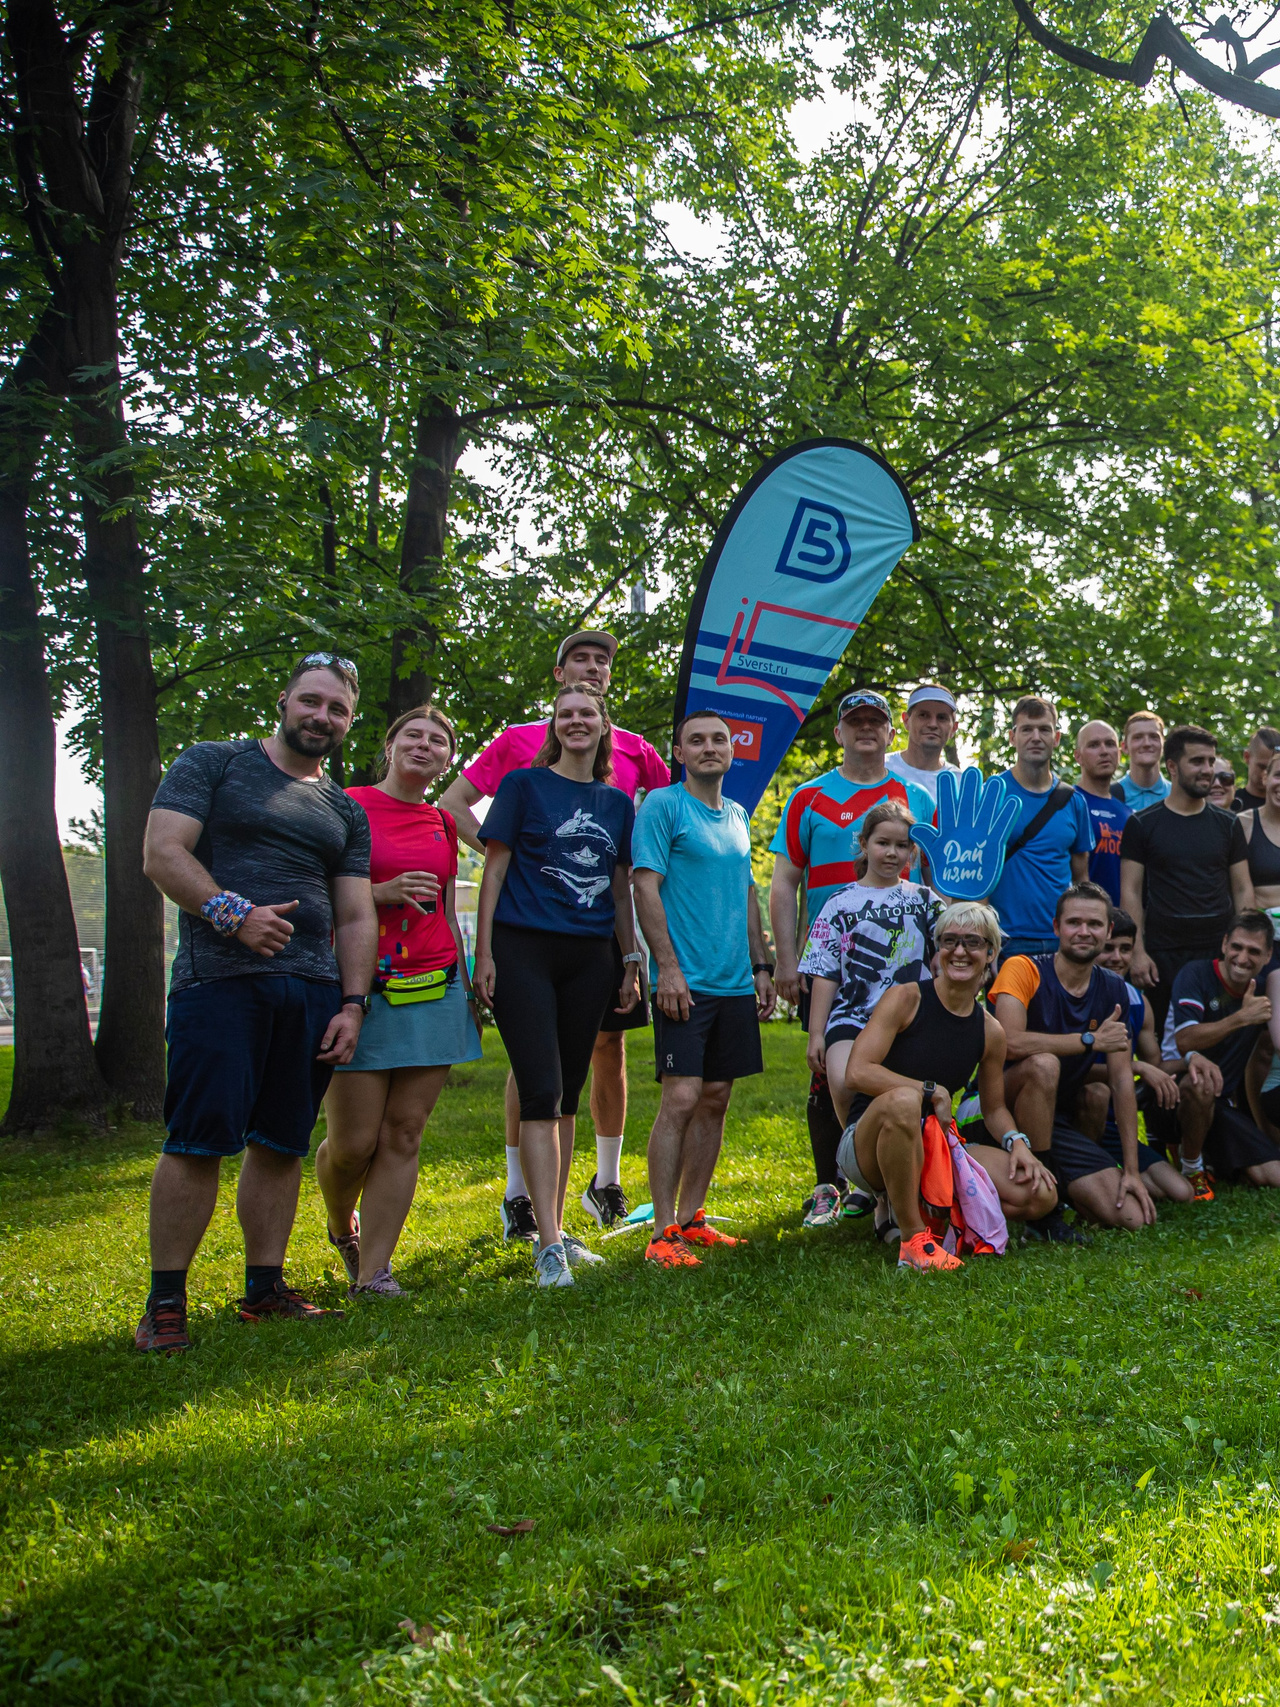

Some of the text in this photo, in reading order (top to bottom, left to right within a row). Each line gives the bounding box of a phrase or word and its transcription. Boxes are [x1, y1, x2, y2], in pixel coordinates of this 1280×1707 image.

[737, 655, 789, 676] 5verst.ru
[943, 839, 987, 865] Дай
[942, 866, 984, 883] пять
[846, 902, 929, 926] PLAYTODAY
